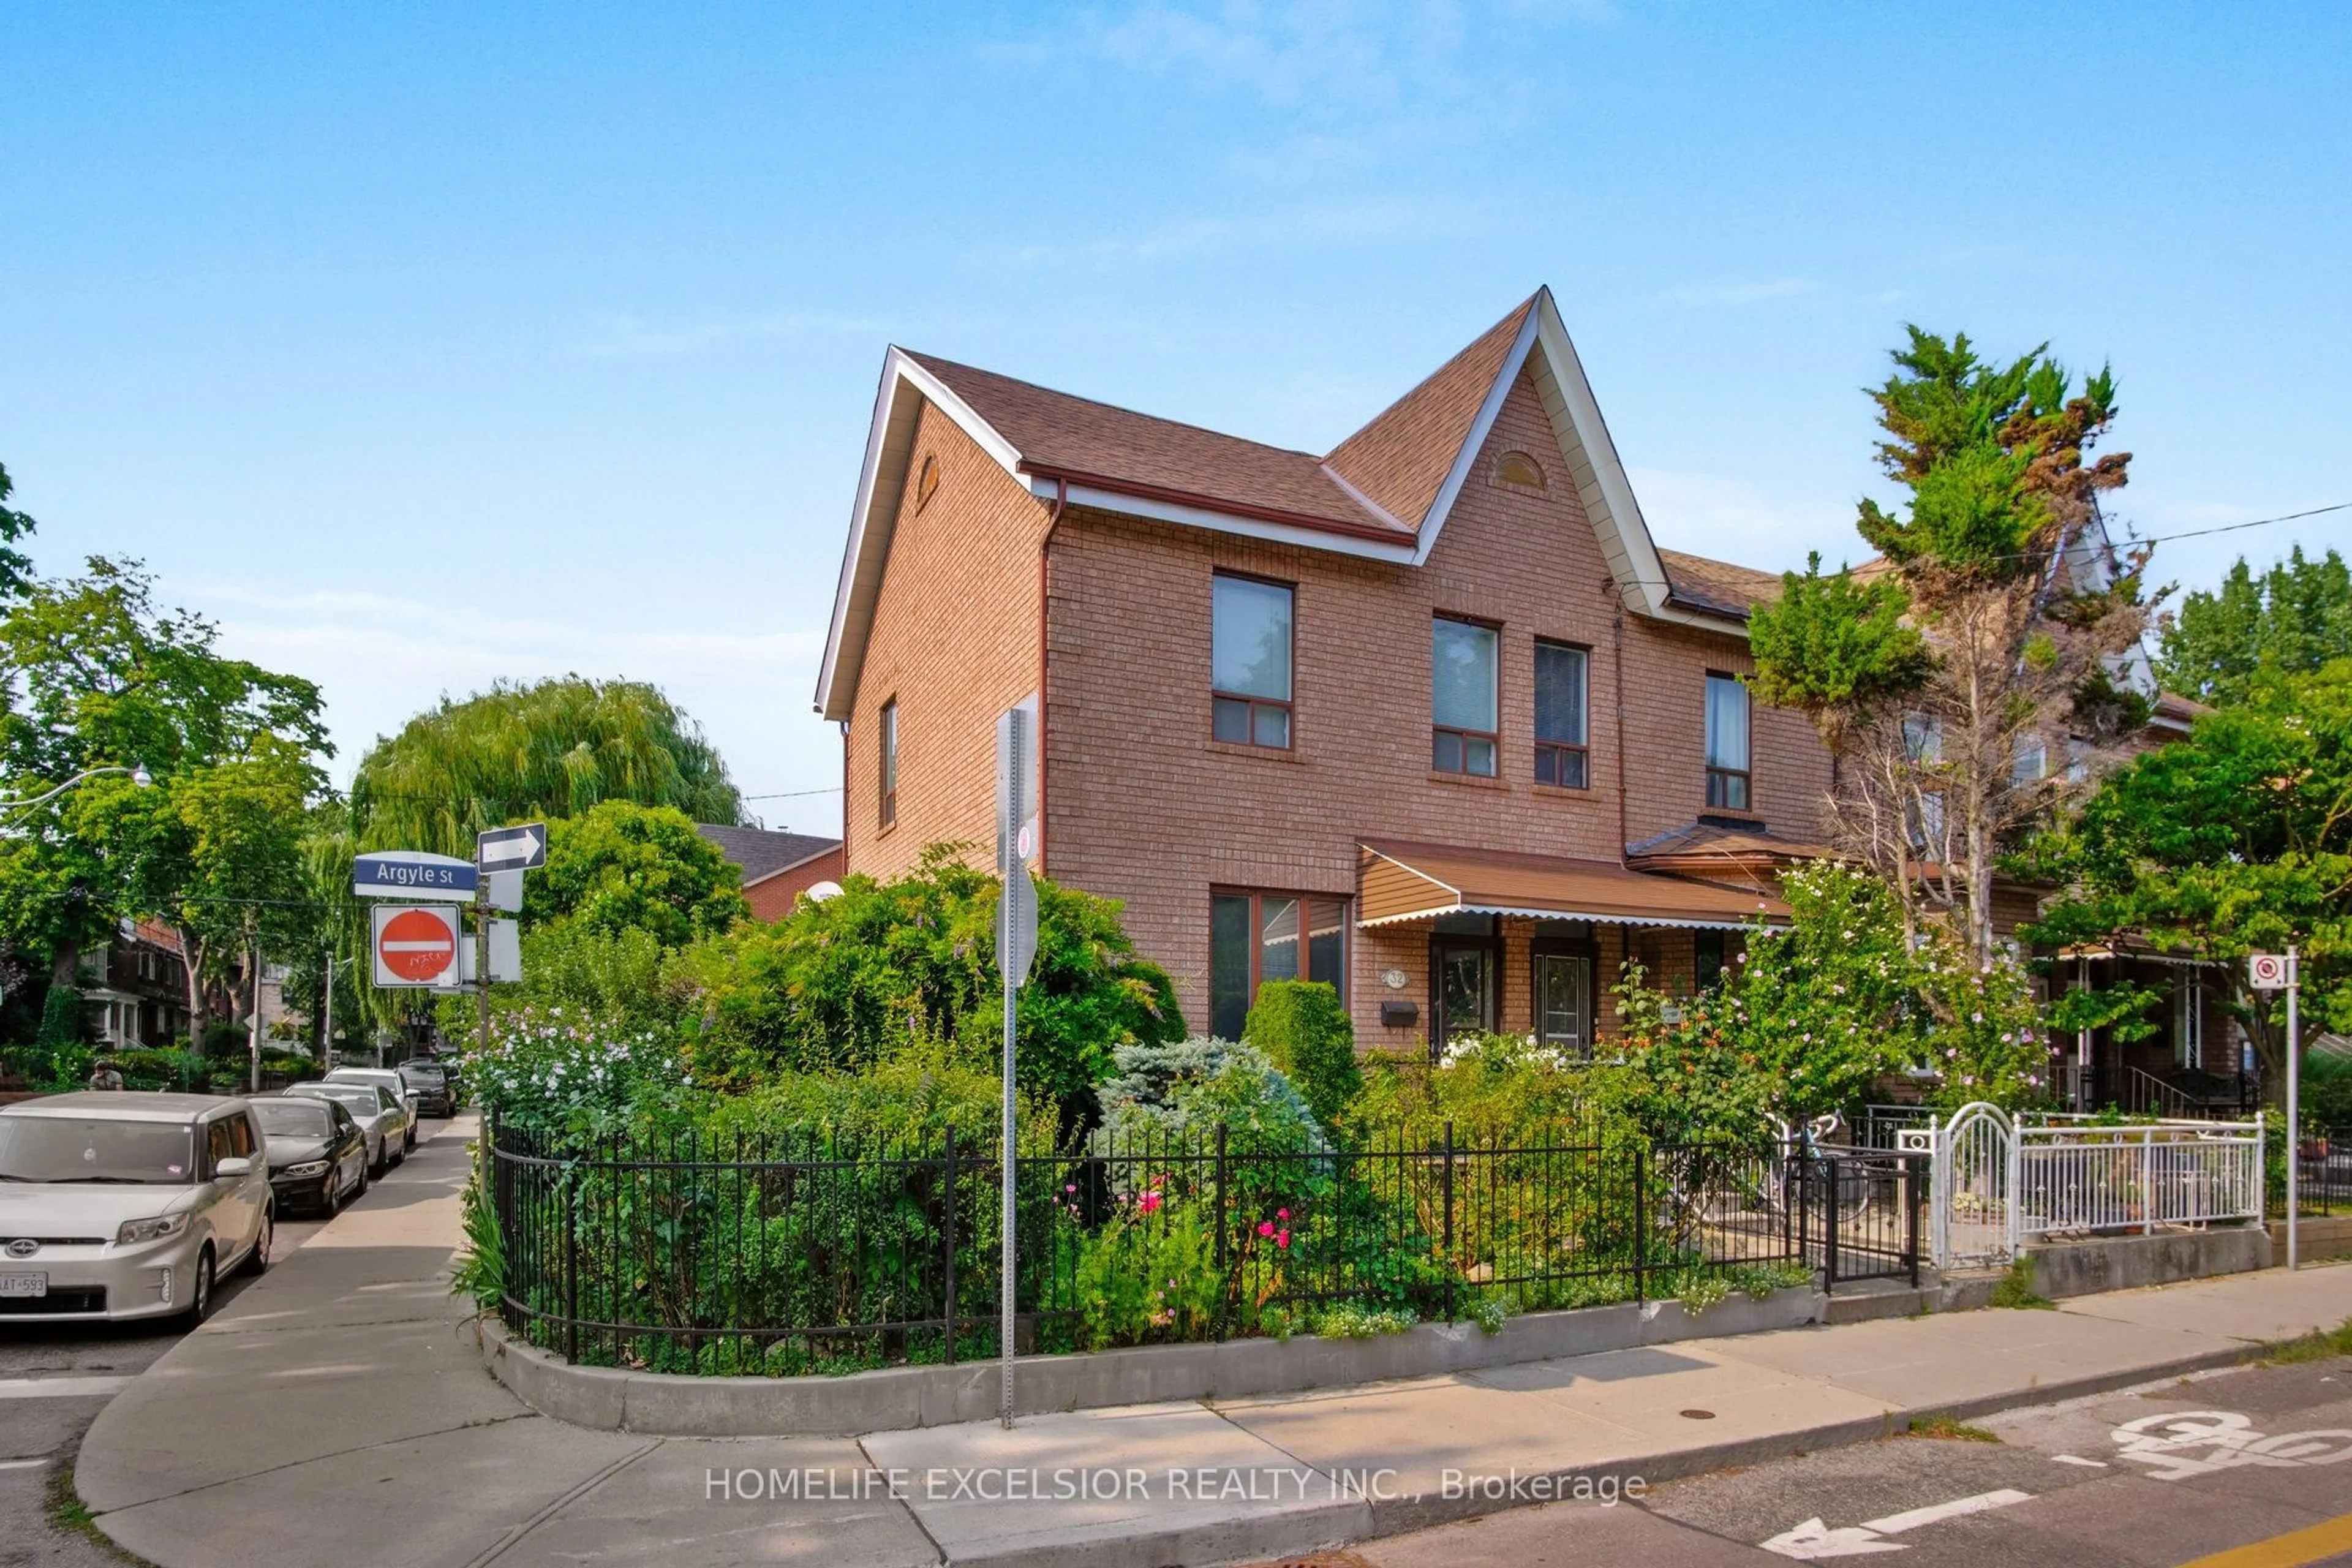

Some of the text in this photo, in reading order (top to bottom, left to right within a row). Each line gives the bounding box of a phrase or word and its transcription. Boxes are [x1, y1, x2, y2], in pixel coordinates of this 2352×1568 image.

[377, 863, 453, 884] Argyle St
[1390, 973, 1403, 983] 32
[0, 1278, 15, 1290] AT
